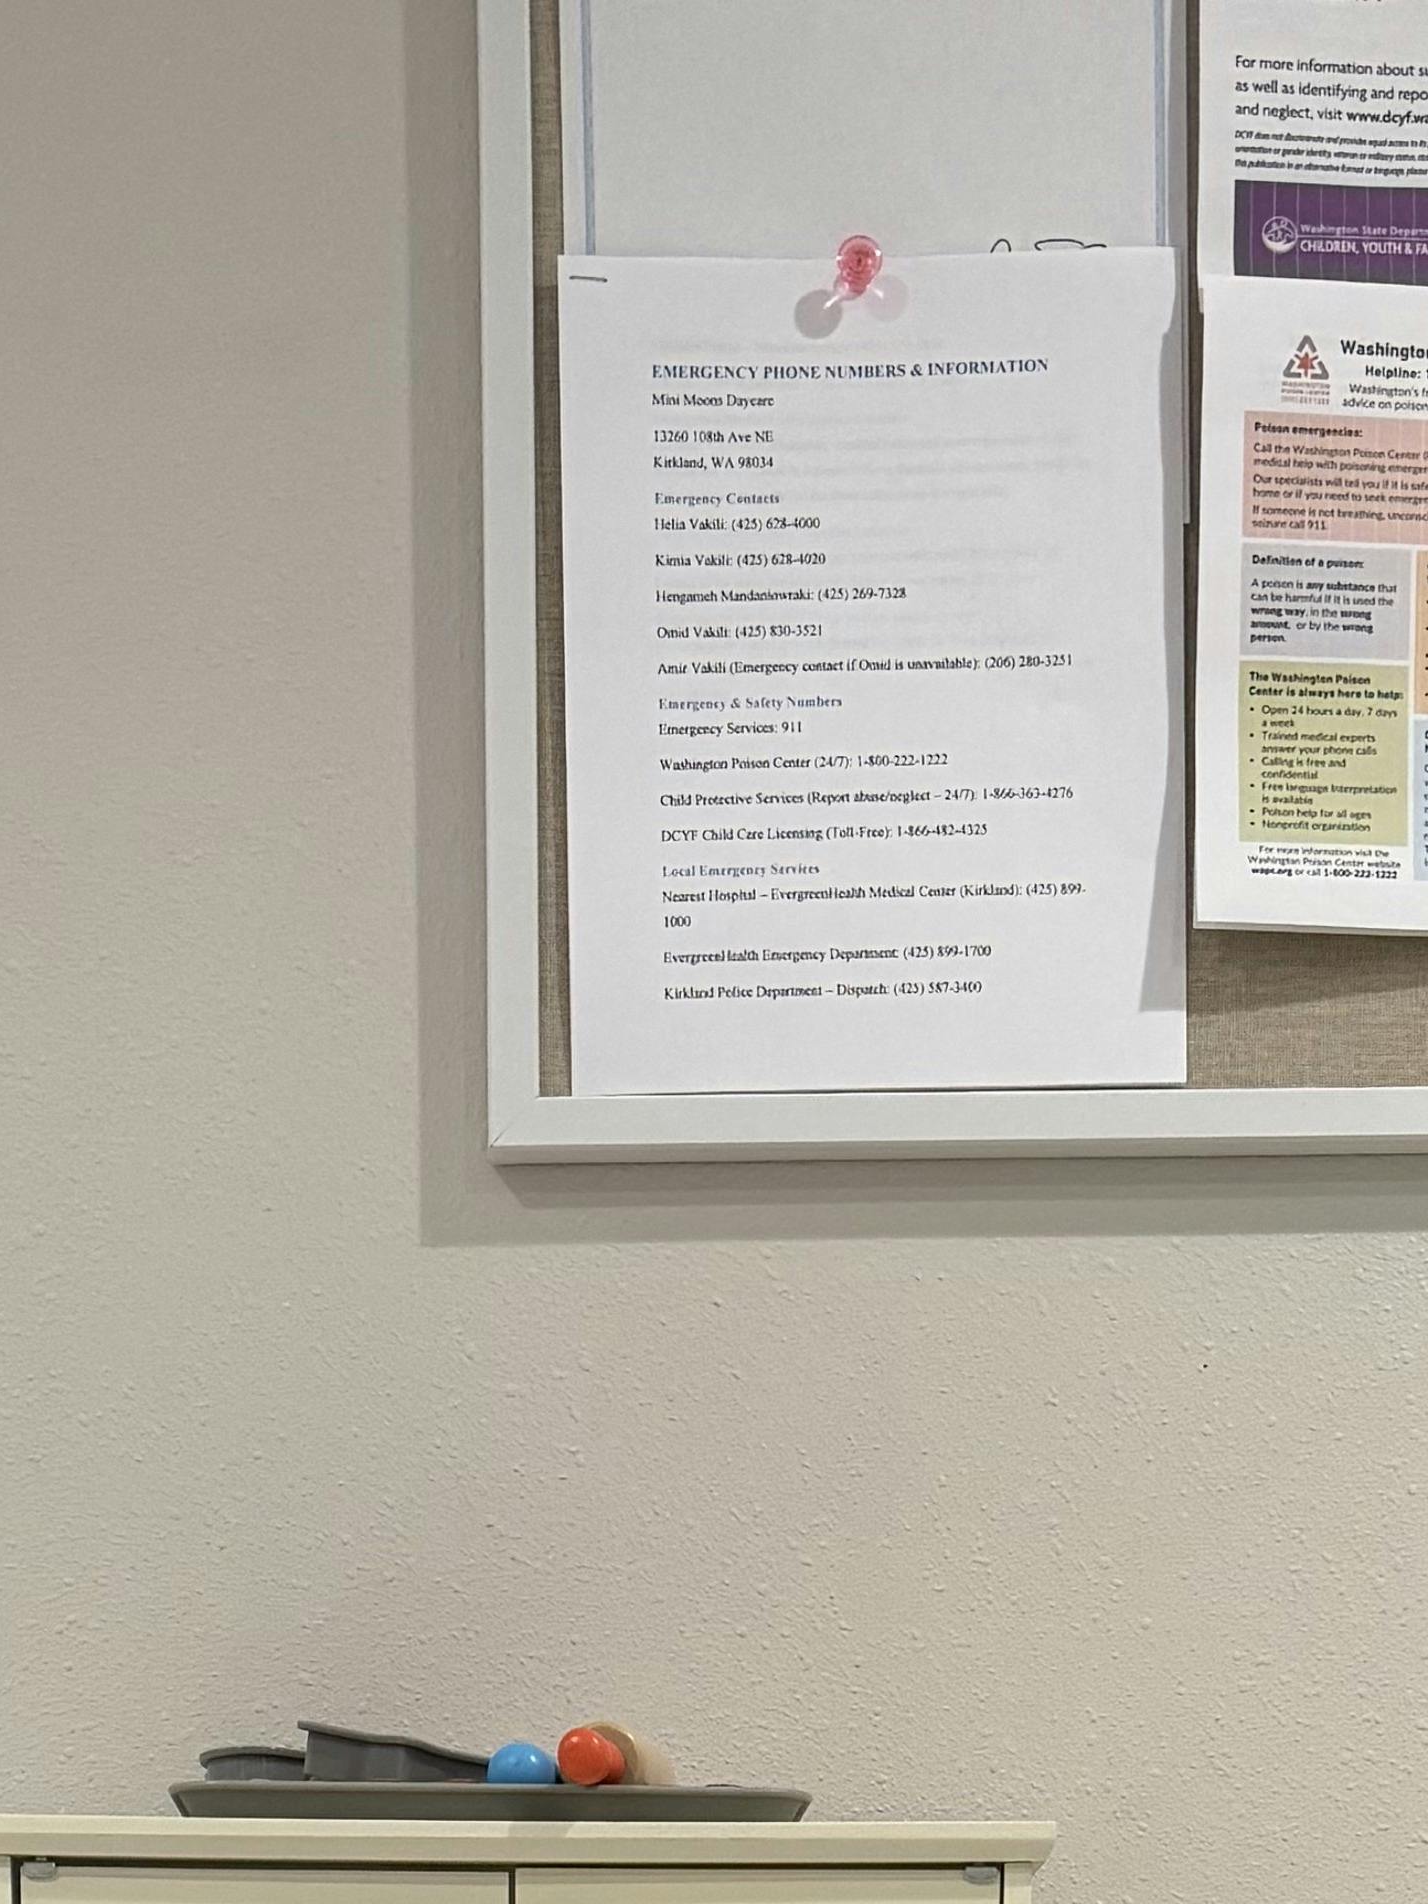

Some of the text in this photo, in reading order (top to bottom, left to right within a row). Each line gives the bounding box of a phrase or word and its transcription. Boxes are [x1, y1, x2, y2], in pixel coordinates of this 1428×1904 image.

[1235, 54, 1257, 69] For
[1259, 58, 1294, 72] more
[1296, 57, 1374, 76] information
[1375, 61, 1416, 77] about
[1234, 81, 1250, 93] as
[1251, 80, 1279, 94] well
[1281, 84, 1296, 95] as
[1298, 81, 1368, 103] identifying
[1370, 85, 1395, 100] and
[1234, 103, 1260, 117] and
[1262, 104, 1314, 122] neglect,
[1316, 107, 1343, 121] visit
[1300, 225, 1360, 238] Washington
[1361, 225, 1388, 236] State
[1361, 241, 1402, 255] YOUTH
[1404, 242, 1413, 255] &
[652, 358, 1048, 380] EMERGENCY PHONE NUMBERS & INFORMATION
[1365, 365, 1422, 380] Helpline:
[651, 392, 681, 406] Mini
[726, 393, 775, 411] Daycare
[1341, 397, 1376, 409] advice
[1377, 400, 1393, 410] on
[1254, 420, 1290, 434] Poison
[654, 429, 774, 444] 13260 108th Ave NE
[653, 455, 774, 471] Kirkland, WA 98034
[654, 491, 780, 508] Emergency Contacts
[731, 516, 763, 533] (425)
[655, 553, 692, 567] Kimia
[736, 553, 769, 569] (425)
[656, 625, 690, 639] Omid
[735, 624, 767, 640] (425)
[769, 623, 822, 638] 830-3521
[657, 662, 688, 675] Amir
[691, 660, 727, 675] Vakili
[729, 660, 799, 677] (Emergency
[801, 660, 844, 673] contact
[846, 660, 858, 673] if
[859, 659, 892, 672] Omid
[894, 658, 904, 671] is
[984, 655, 1016, 671] (206)
[658, 694, 843, 713] Emergency & Safety Numbers
[658, 723, 724, 739] Emergency
[781, 720, 802, 733] 911
[659, 758, 729, 773] Washington
[731, 757, 771, 770] Poison
[772, 756, 811, 769] Center
[659, 793, 692, 808] Child
[695, 793, 753, 807] Protective
[755, 792, 805, 805] Services
[806, 790, 851, 807] (Report
[701, 828, 734, 841] Child
[736, 827, 765, 841] Care
